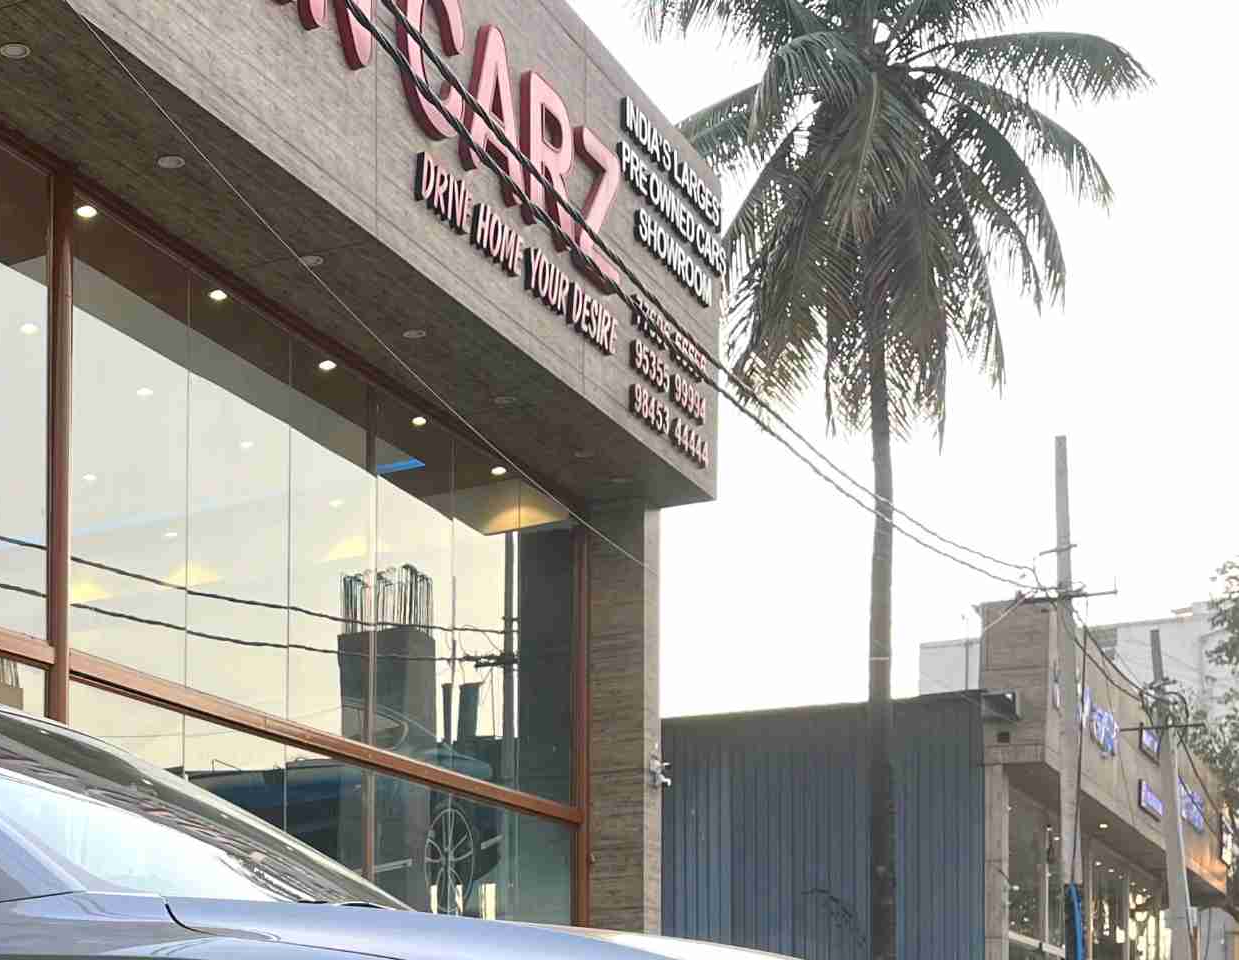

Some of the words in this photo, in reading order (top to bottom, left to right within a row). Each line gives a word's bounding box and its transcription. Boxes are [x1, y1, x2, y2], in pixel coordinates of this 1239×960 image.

[624, 95, 672, 172] INDIA'S
[419, 151, 473, 234] DRIVE
[475, 202, 524, 276] HOME
[528, 247, 569, 316] YOUR
[571, 282, 618, 354] DESIRE
[621, 140, 648, 196] PRE
[649, 172, 695, 244] OWNED
[696, 223, 727, 274] CARS
[638, 207, 712, 307] SHOWROOM
[634, 338, 670, 393] 95355
[633, 383, 670, 435] 98453
[674, 417, 710, 470] 44444
